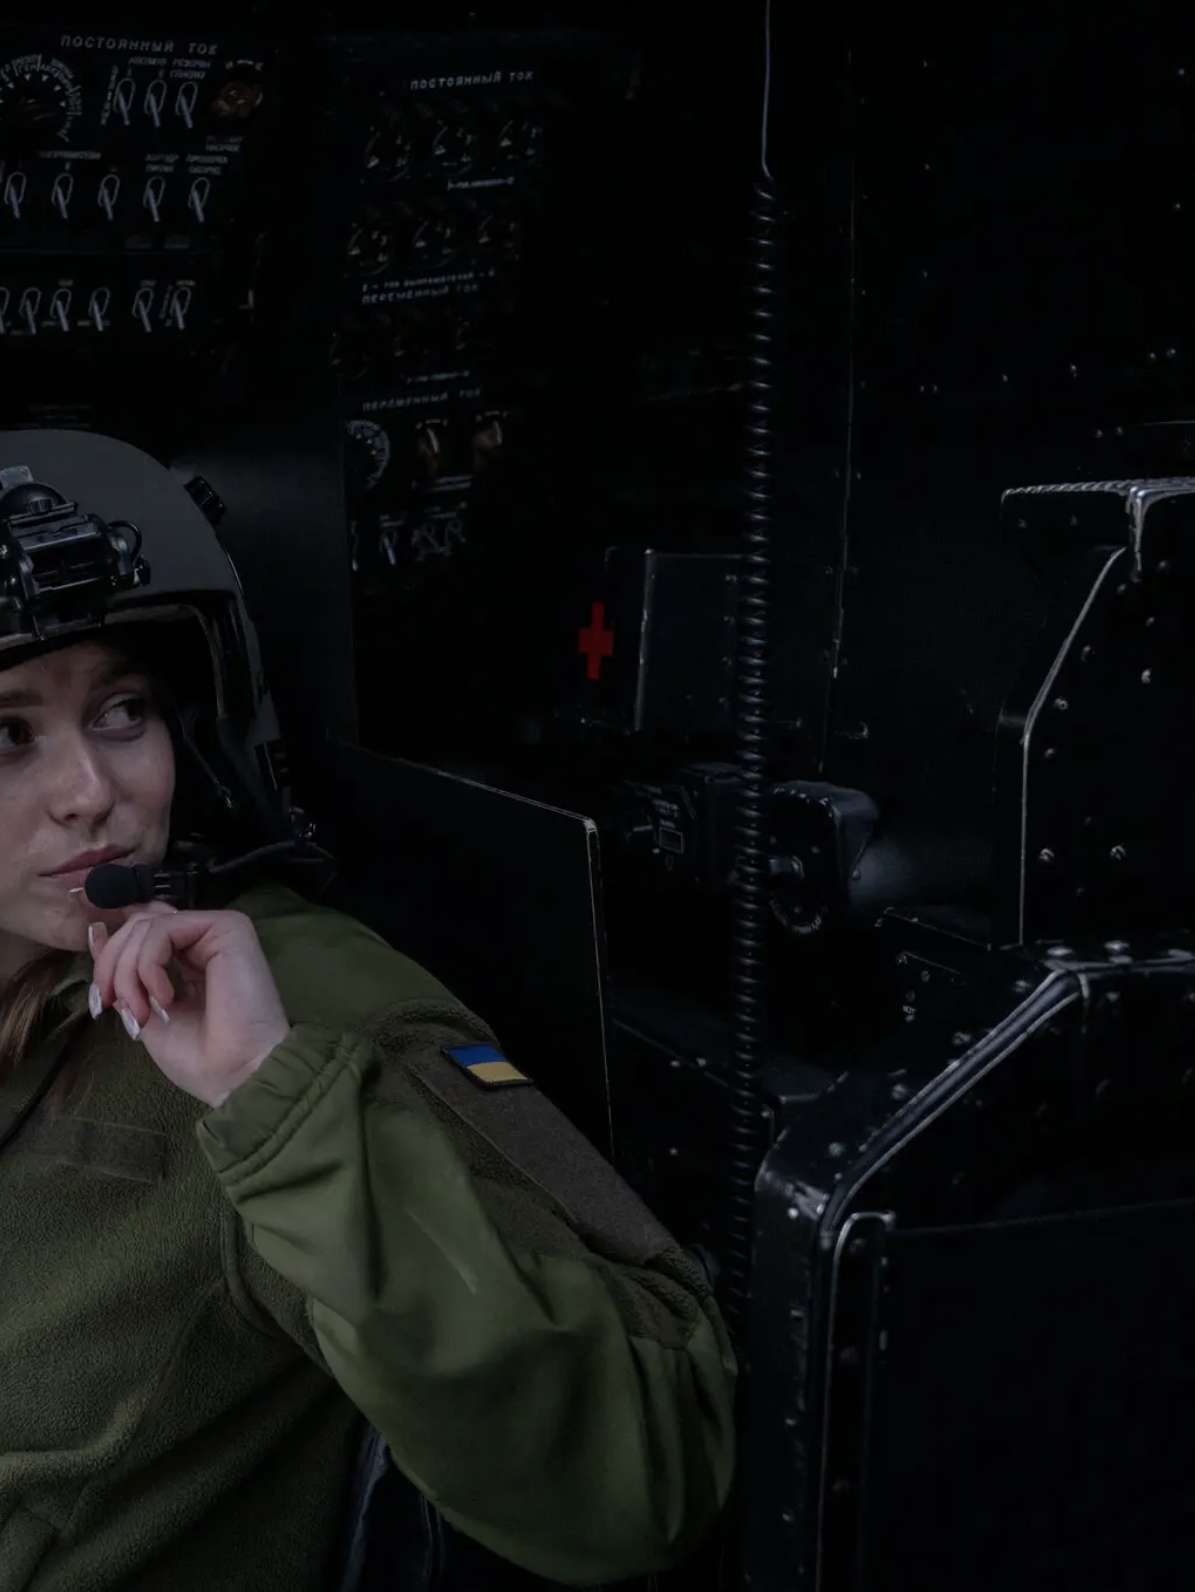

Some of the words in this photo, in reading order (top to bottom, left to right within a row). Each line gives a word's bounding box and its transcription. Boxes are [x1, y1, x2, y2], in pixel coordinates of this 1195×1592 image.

[59, 34, 176, 54] ПОСТОЯННЫЙ
[188, 42, 220, 56] ТОК
[409, 70, 503, 91] ПОСТОЯННЫЙ
[509, 69, 534, 83] ТОК
